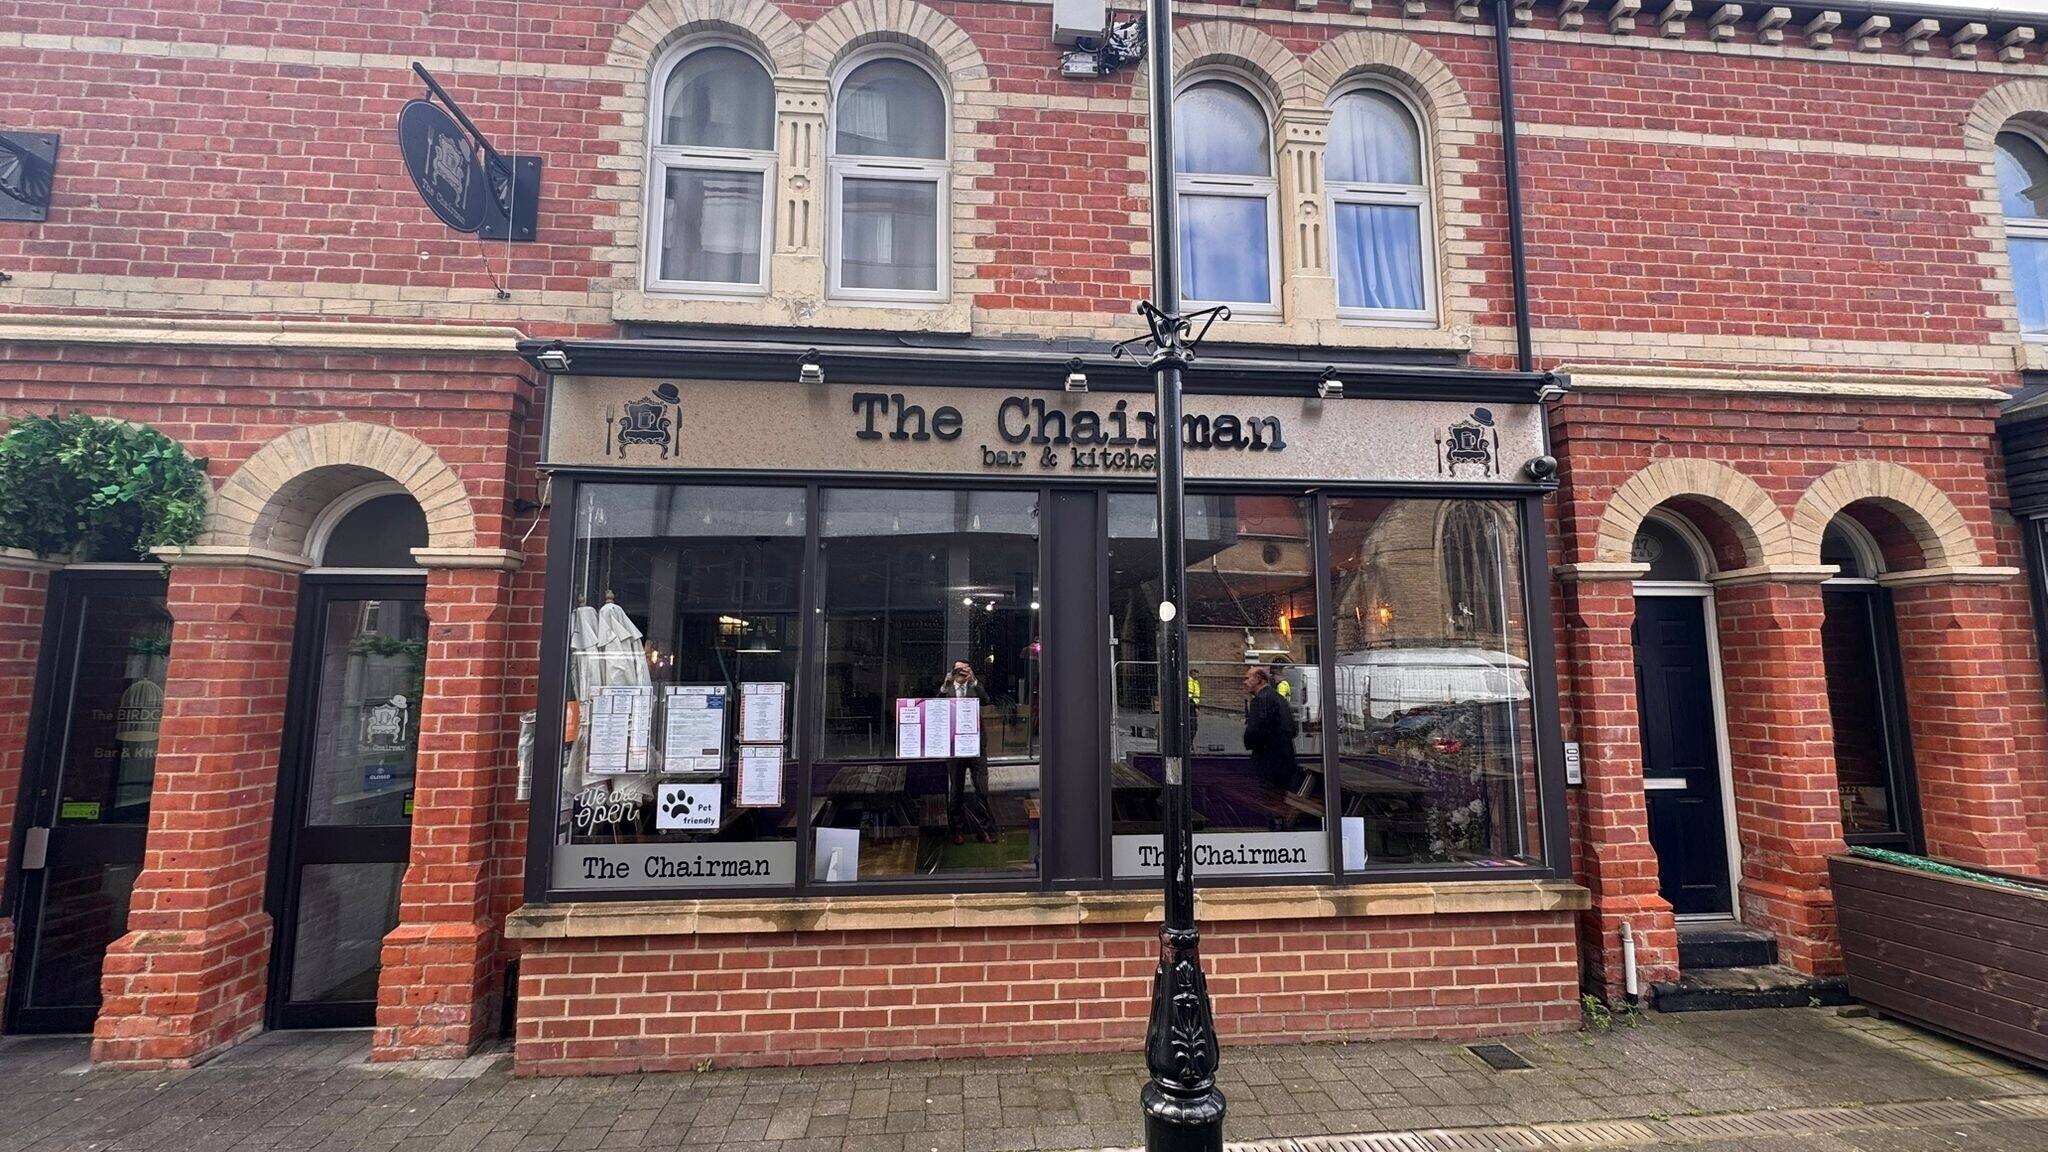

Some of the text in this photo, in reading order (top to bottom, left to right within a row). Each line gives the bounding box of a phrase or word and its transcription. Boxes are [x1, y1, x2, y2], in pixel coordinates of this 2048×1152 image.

[853, 393, 963, 441] The
[981, 445, 1157, 471] bar & kitche
[92, 708, 162, 721] The BIRDC
[94, 747, 118, 759] Bar
[698, 804, 712, 812] Pet
[683, 816, 716, 826] friendly
[1138, 844, 1307, 867] Th Chairman
[583, 856, 770, 879] The Chairman
